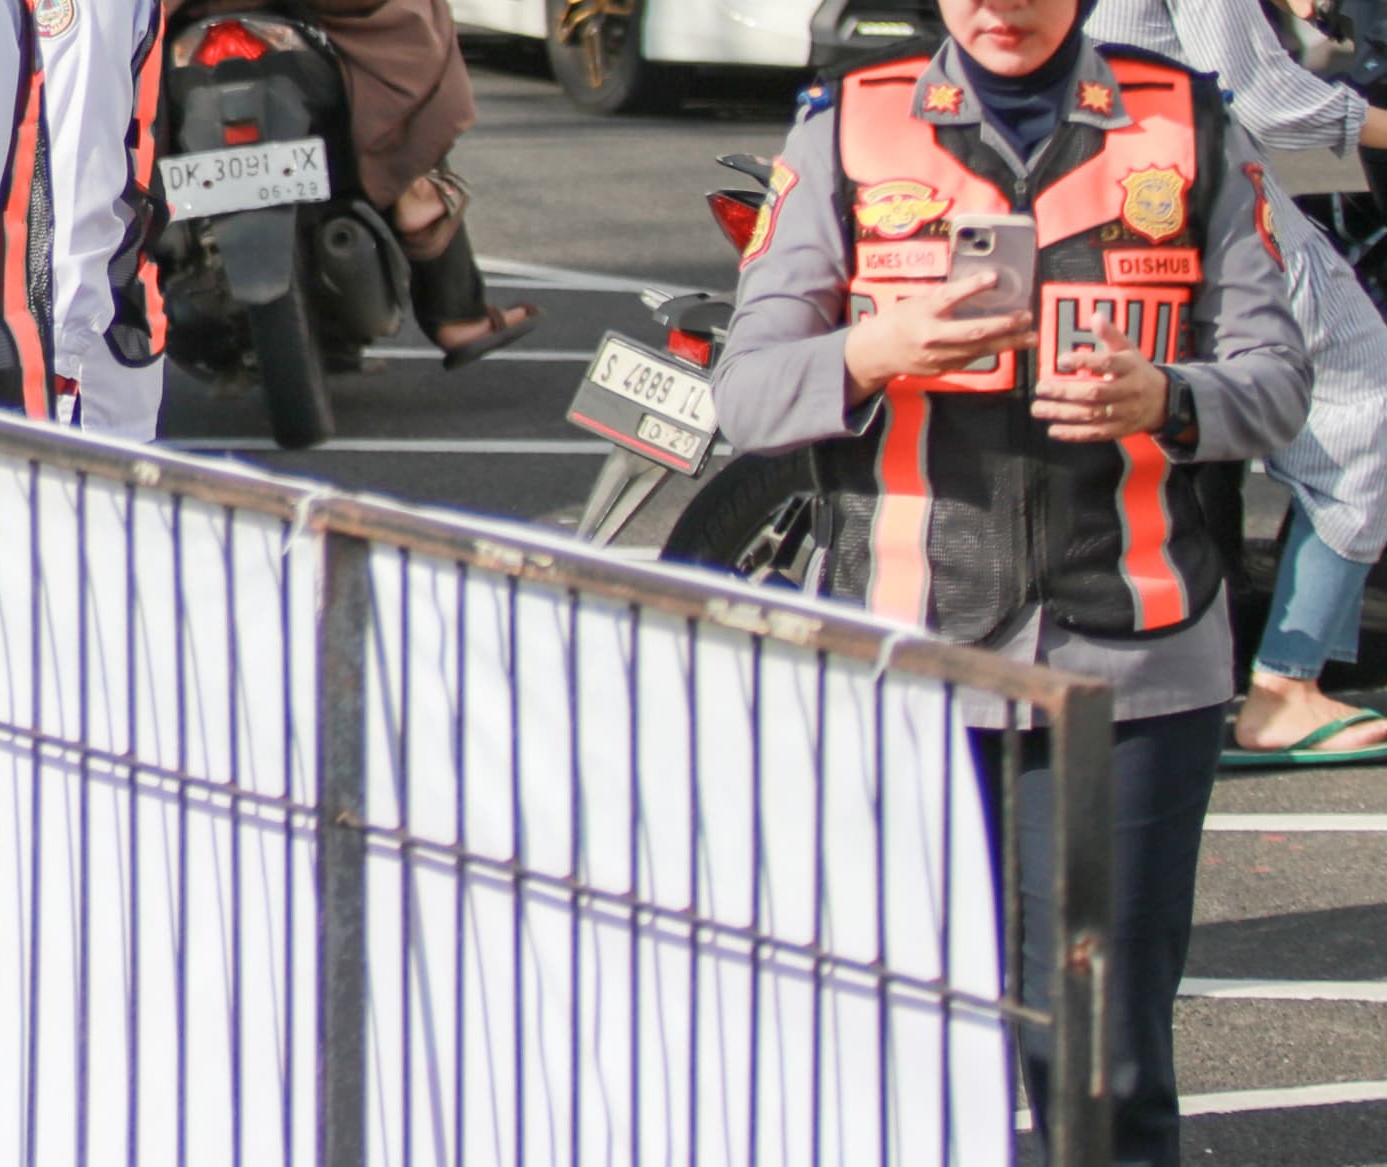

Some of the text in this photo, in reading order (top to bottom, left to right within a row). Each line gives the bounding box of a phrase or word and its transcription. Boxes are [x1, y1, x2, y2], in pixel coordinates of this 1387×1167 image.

[170, 162, 199, 190] DK
[1118, 258, 1190, 274] DISHUB
[601, 353, 618, 381] S
[623, 363, 676, 404] 4889
